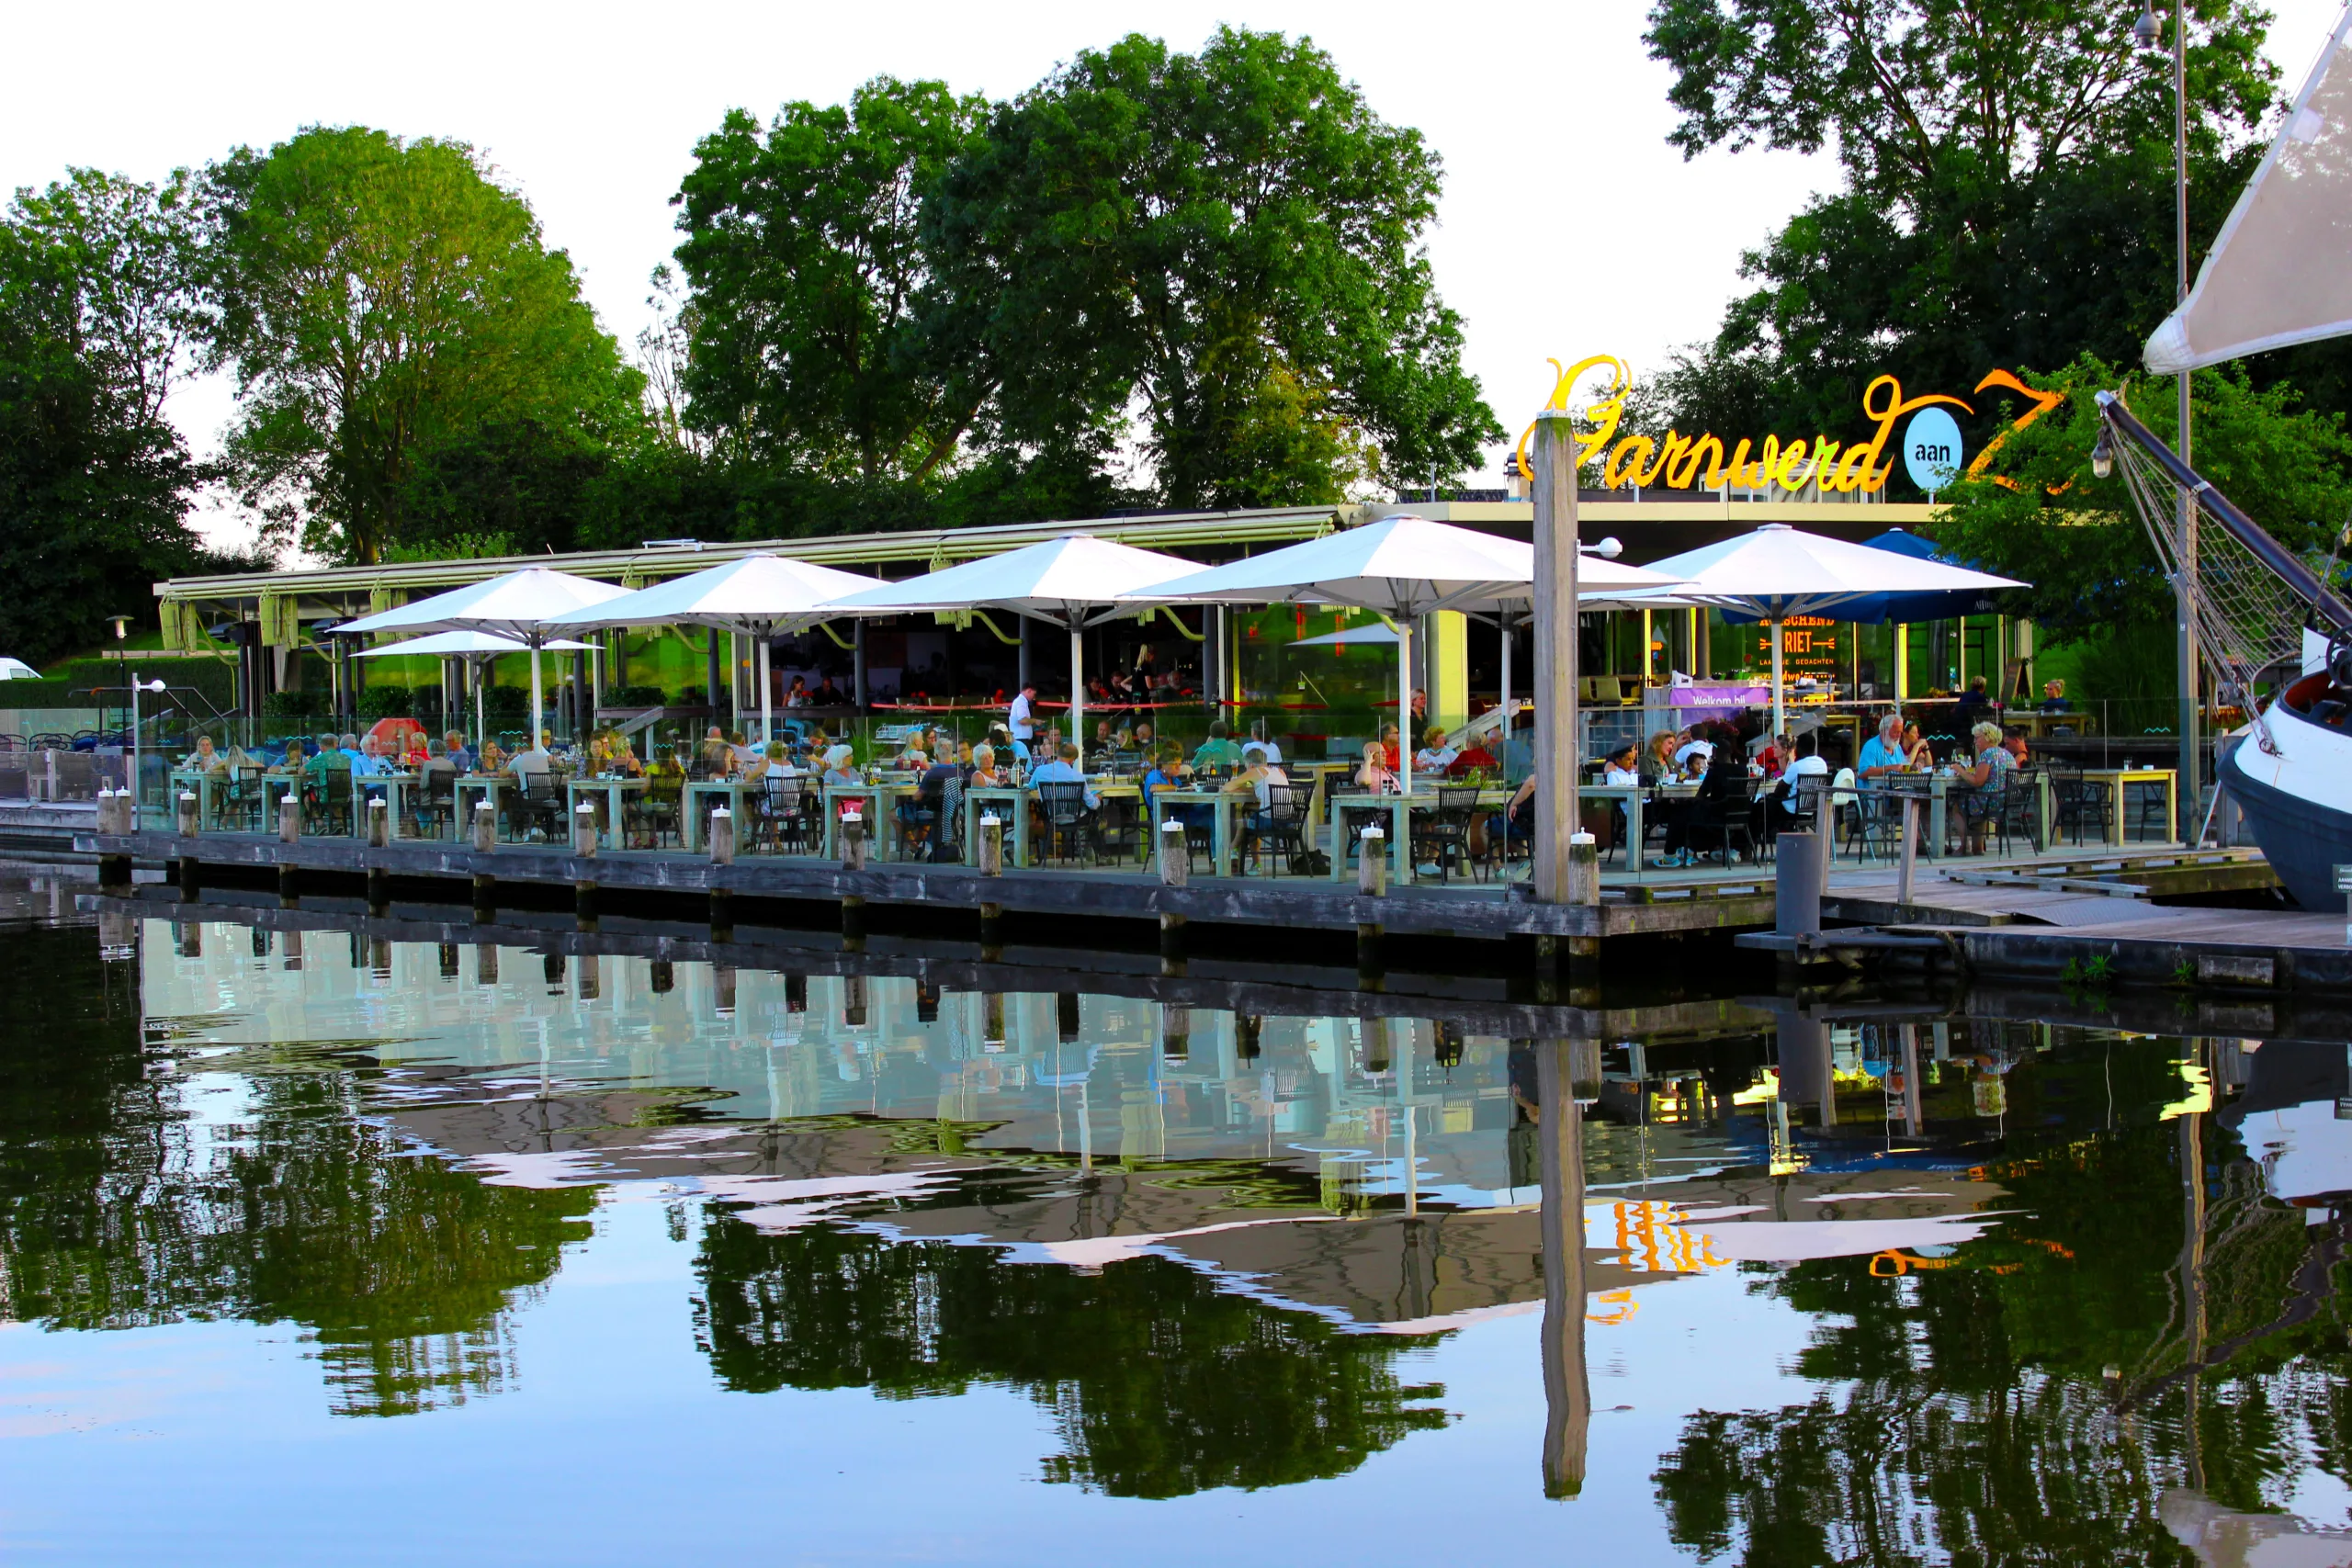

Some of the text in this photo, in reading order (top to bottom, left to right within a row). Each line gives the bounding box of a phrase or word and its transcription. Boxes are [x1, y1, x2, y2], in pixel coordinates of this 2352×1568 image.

[1915, 444, 1951, 462] aan
[1784, 631, 1813, 653] RIET
[1692, 695, 1732, 705] Welkom
